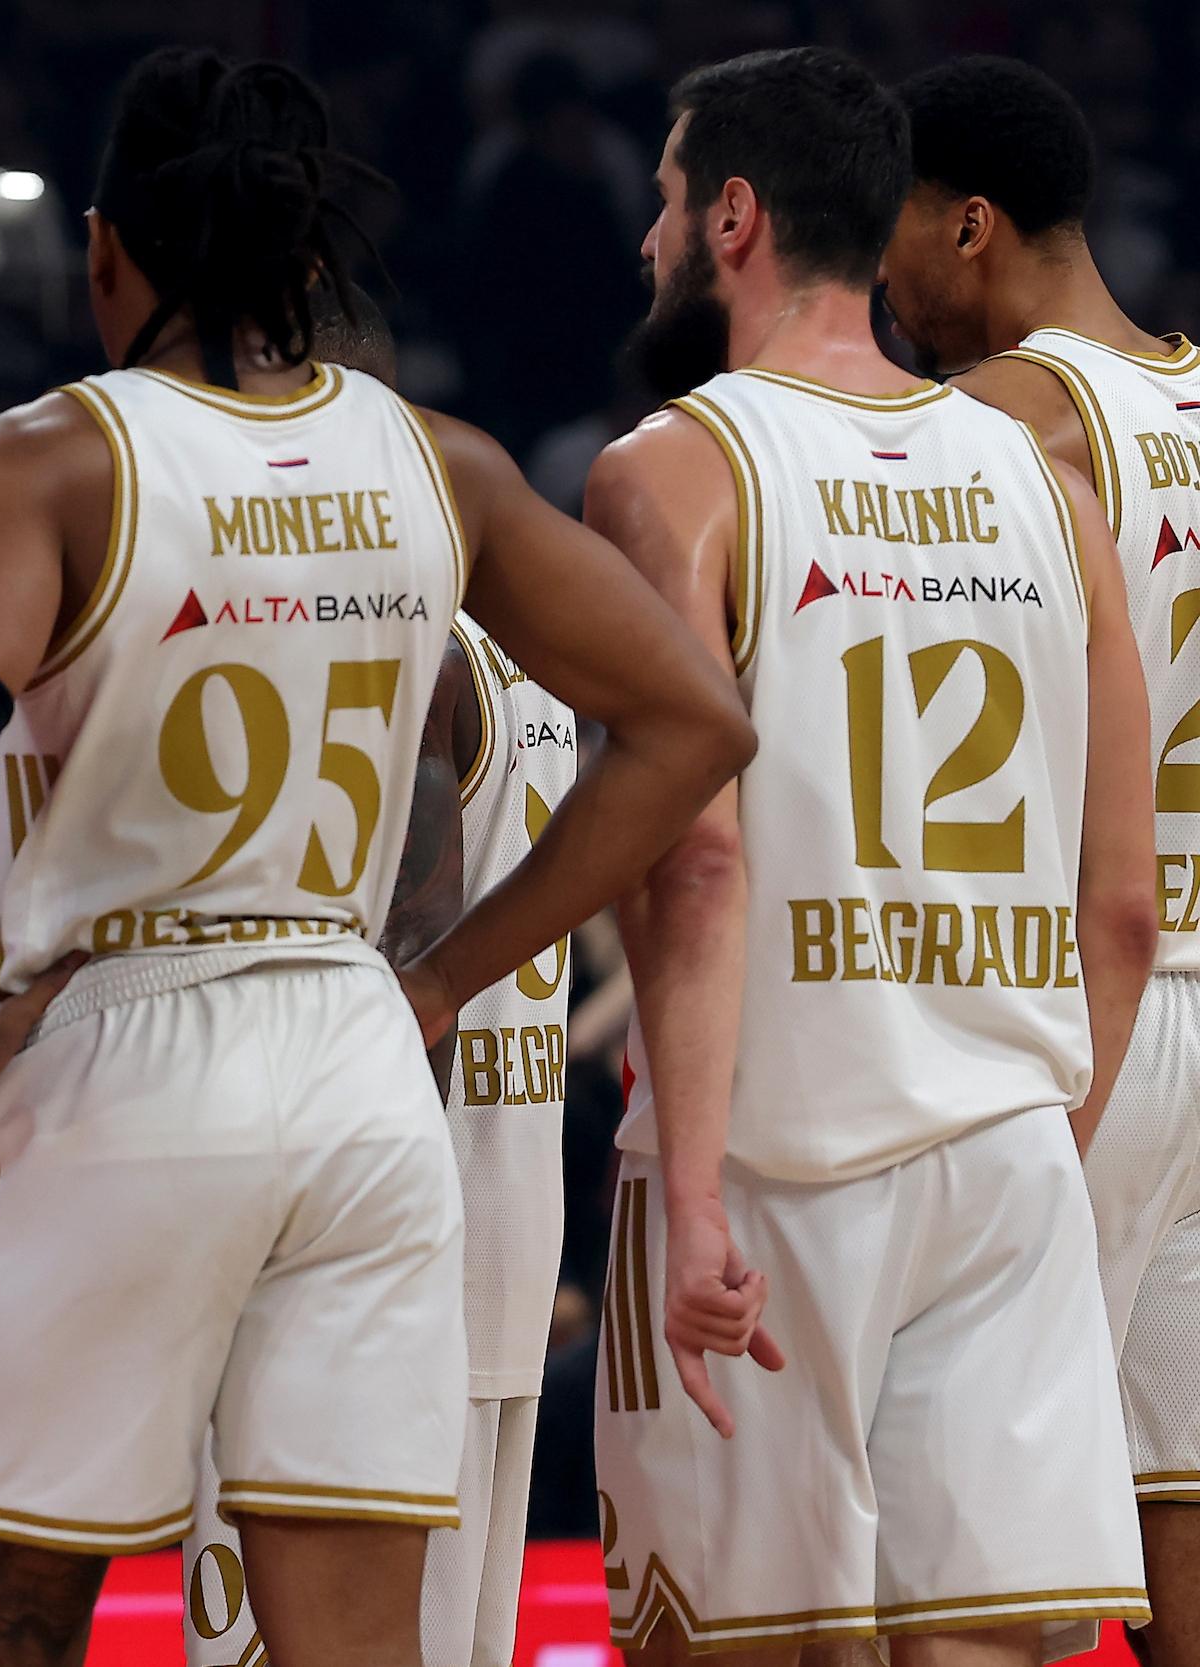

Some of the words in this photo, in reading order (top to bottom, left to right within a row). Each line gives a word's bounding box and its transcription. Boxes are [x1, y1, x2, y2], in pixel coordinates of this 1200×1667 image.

[204, 490, 399, 556] MONEKE
[814, 471, 1000, 545] KALINIĆ
[525, 721, 574, 751] BAA
[840, 634, 1026, 873] 12
[158, 657, 402, 898] 95
[1156, 854, 1200, 932] EL
[787, 897, 1080, 989] BEGRADE
